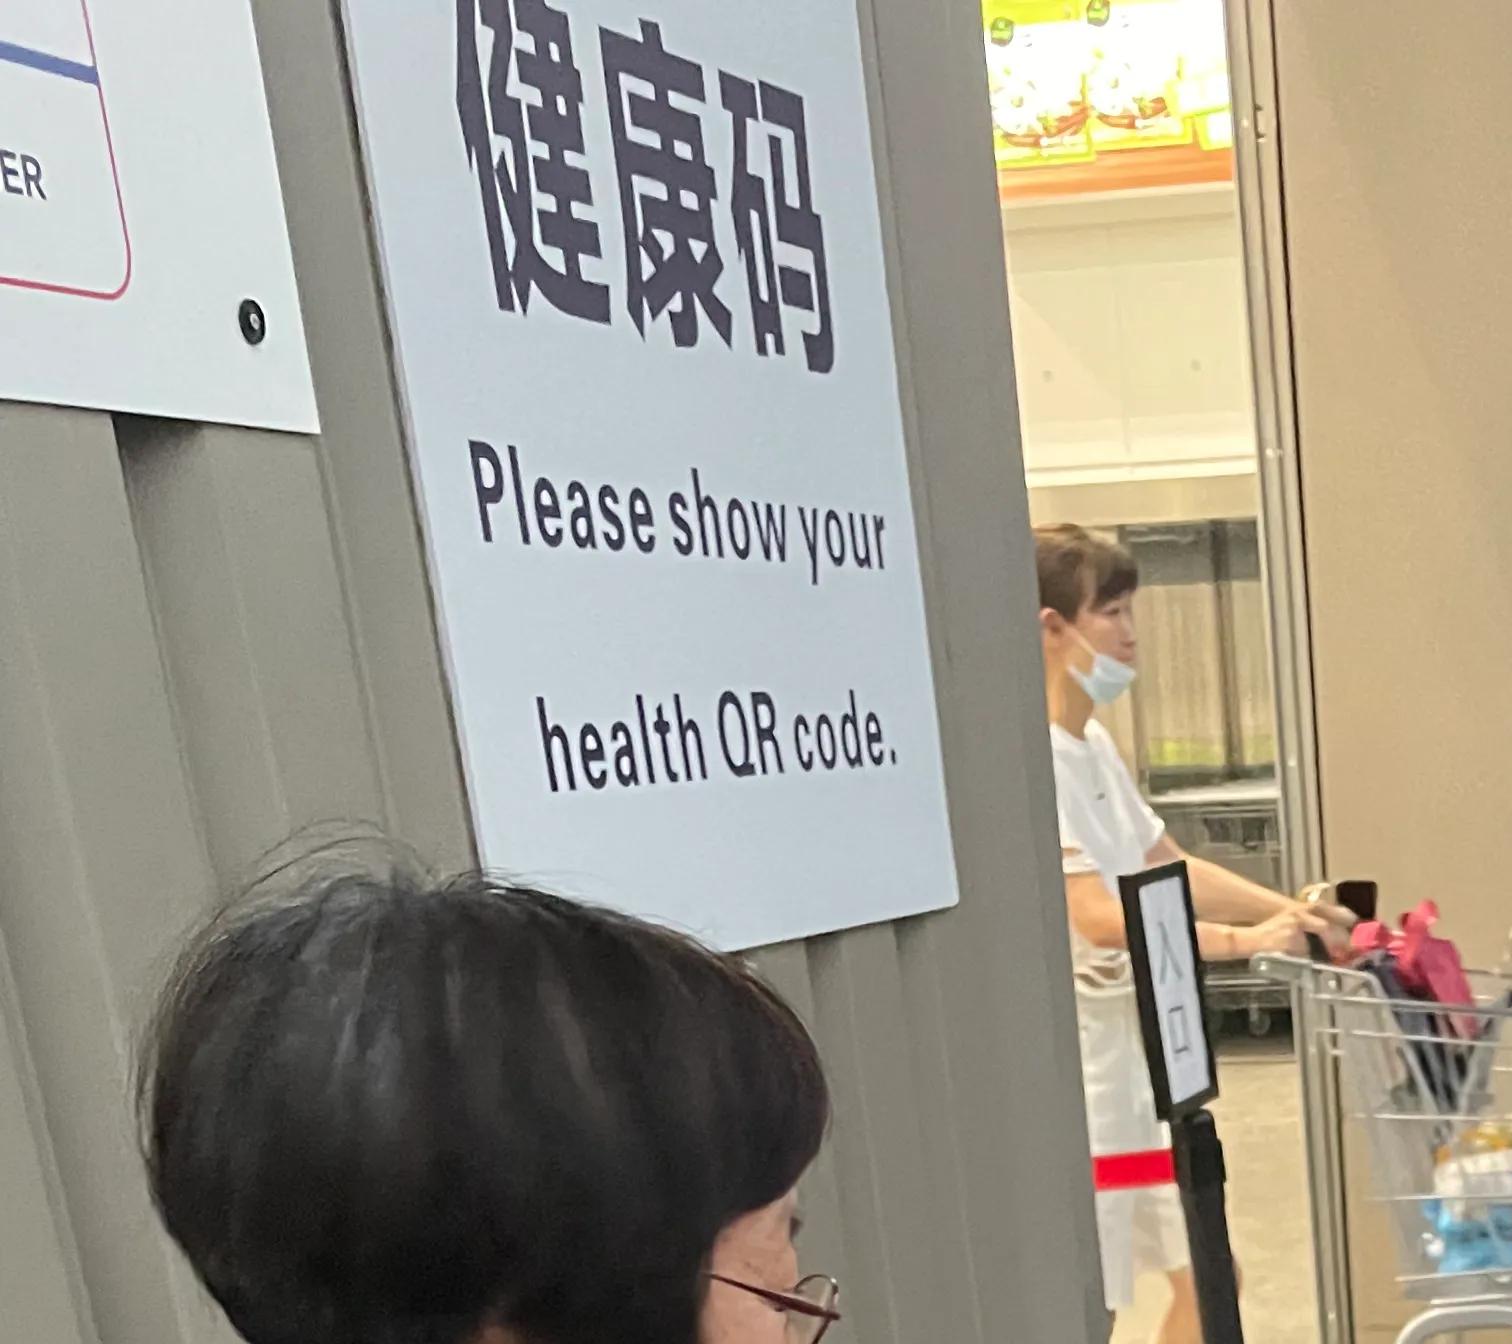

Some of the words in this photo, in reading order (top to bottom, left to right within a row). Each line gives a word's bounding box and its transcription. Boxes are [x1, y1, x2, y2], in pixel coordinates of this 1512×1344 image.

[0, 149, 47, 200] ER
[456, 0, 834, 373] 健康码
[468, 439, 656, 553] Please
[668, 467, 786, 562] show
[797, 504, 885, 585] your
[536, 692, 708, 793] health
[717, 689, 785, 778] QR
[794, 689, 897, 772] code.
[1157, 920, 1192, 1064] 入口
